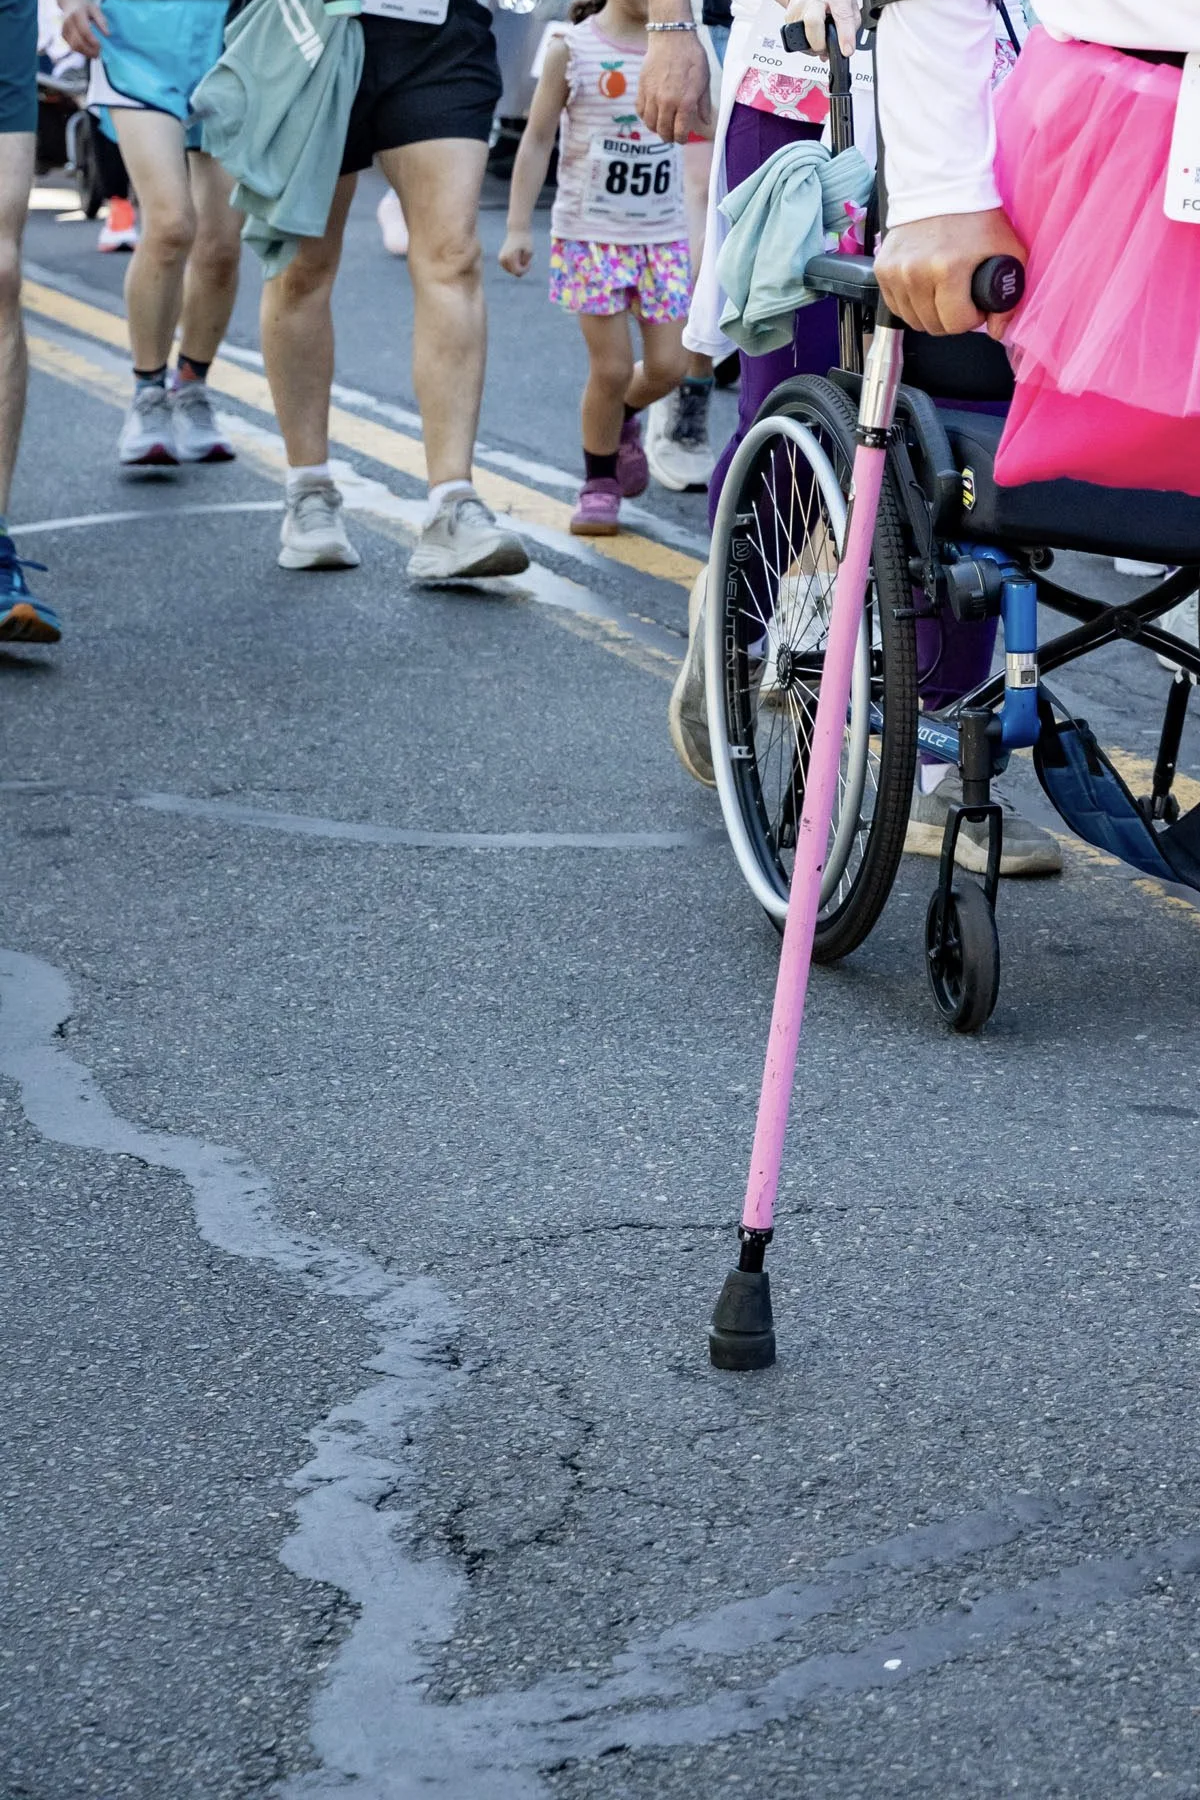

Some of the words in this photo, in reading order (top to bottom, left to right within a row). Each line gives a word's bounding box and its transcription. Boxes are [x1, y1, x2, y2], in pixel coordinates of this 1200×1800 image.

[752, 53, 783, 67] FOOD
[803, 65, 830, 76] DRIN
[855, 73, 873, 83] DRI
[603, 139, 674, 155] BIONIC
[605, 159, 671, 196] 856
[726, 563, 739, 671] NEWTON
